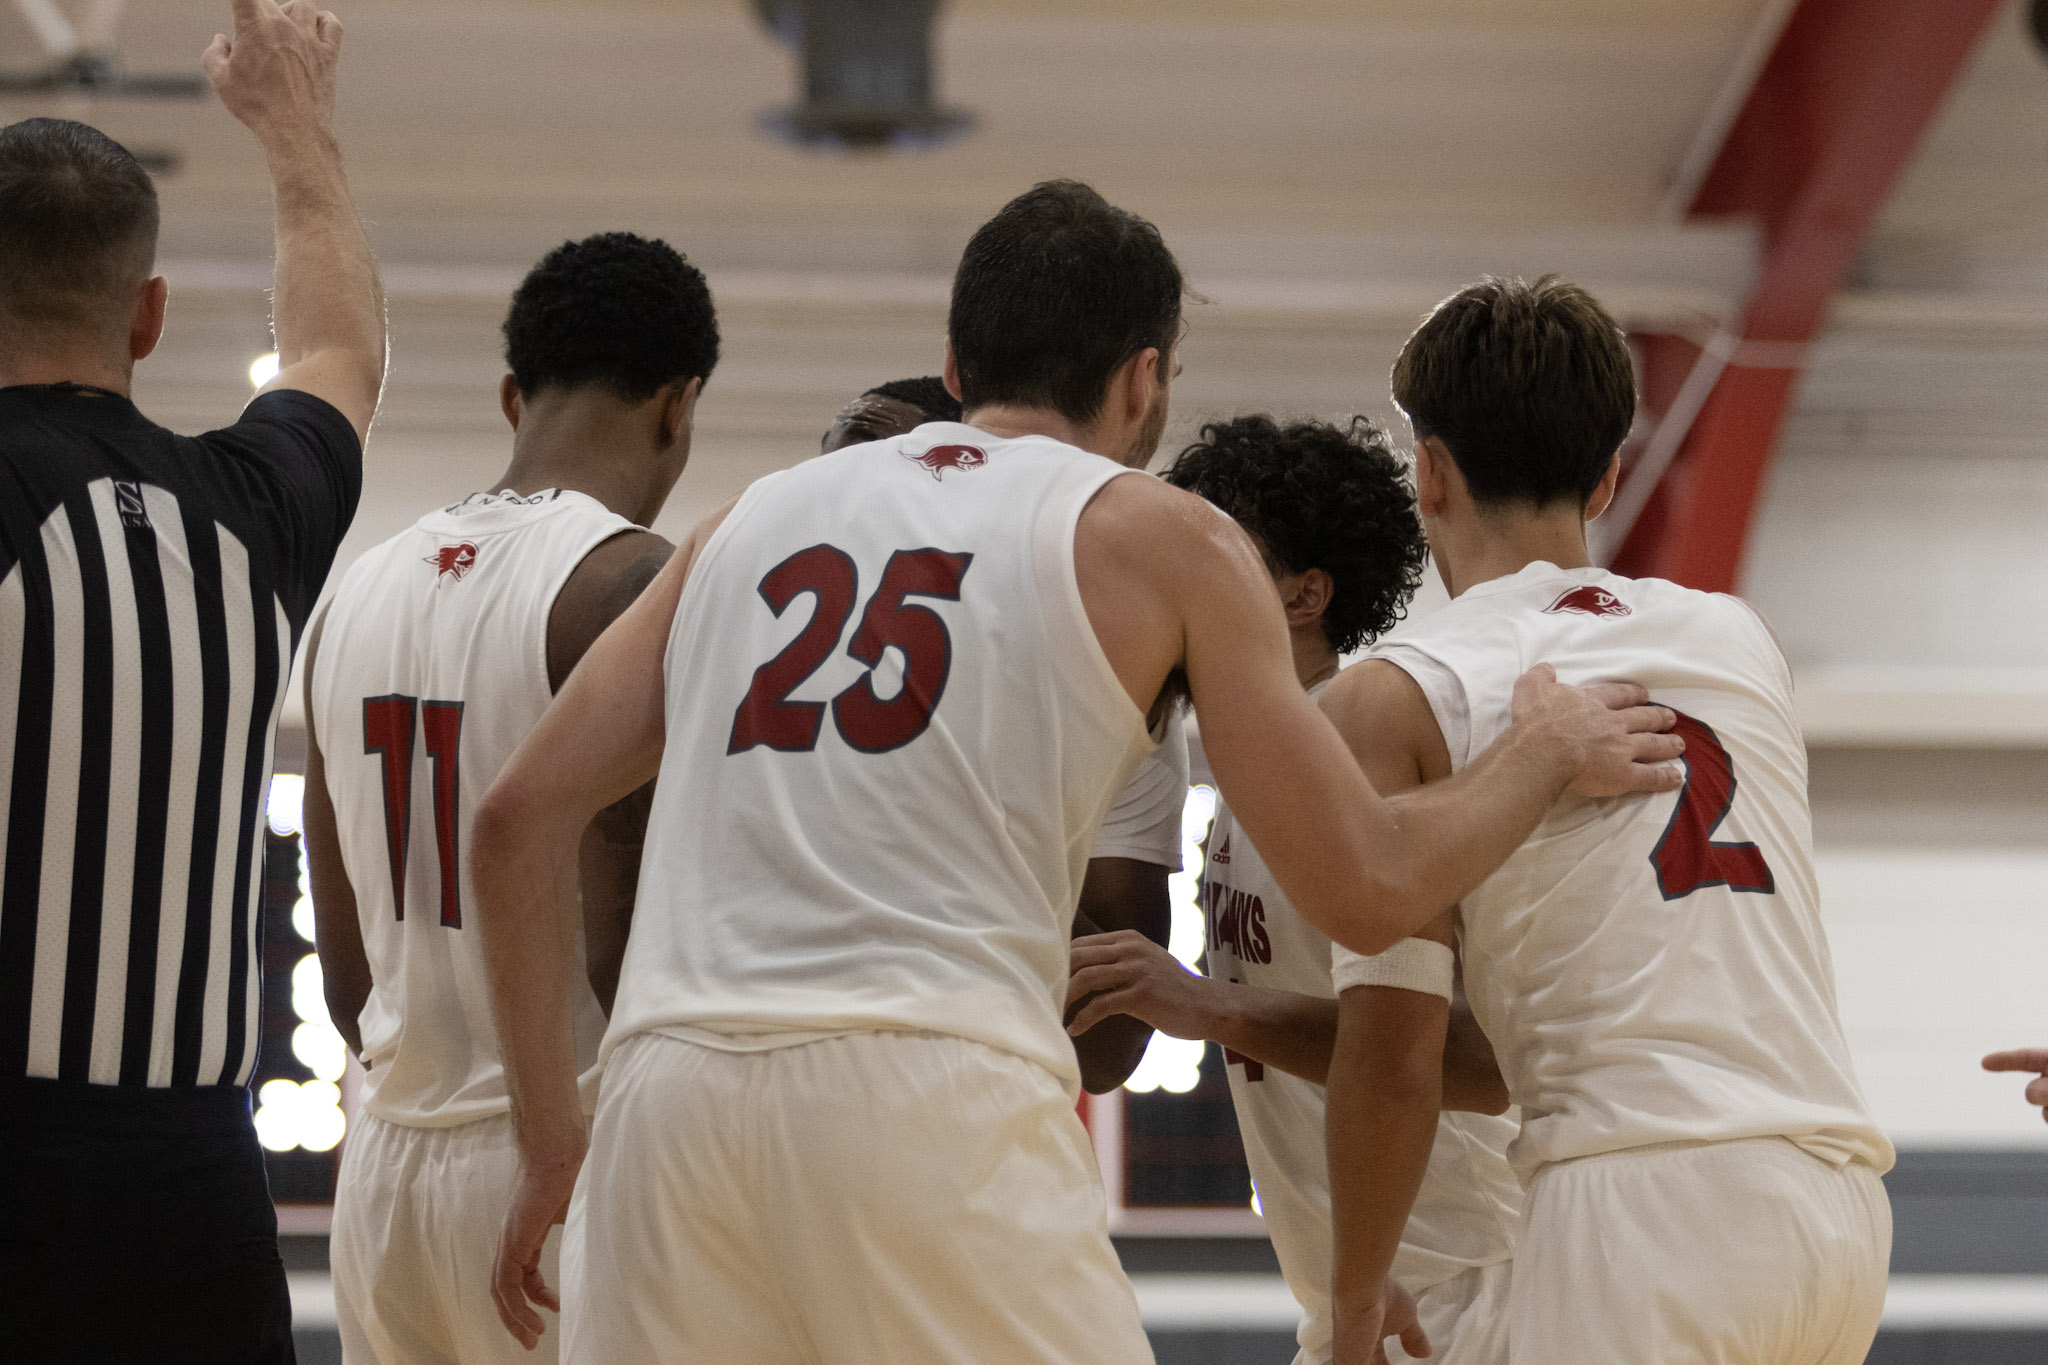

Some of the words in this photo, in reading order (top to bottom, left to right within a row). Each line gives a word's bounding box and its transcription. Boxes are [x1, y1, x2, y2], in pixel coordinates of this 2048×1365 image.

[122, 515, 152, 528] USA
[726, 542, 975, 757] 25
[362, 693, 465, 930] 11
[1647, 700, 1775, 902] 2
